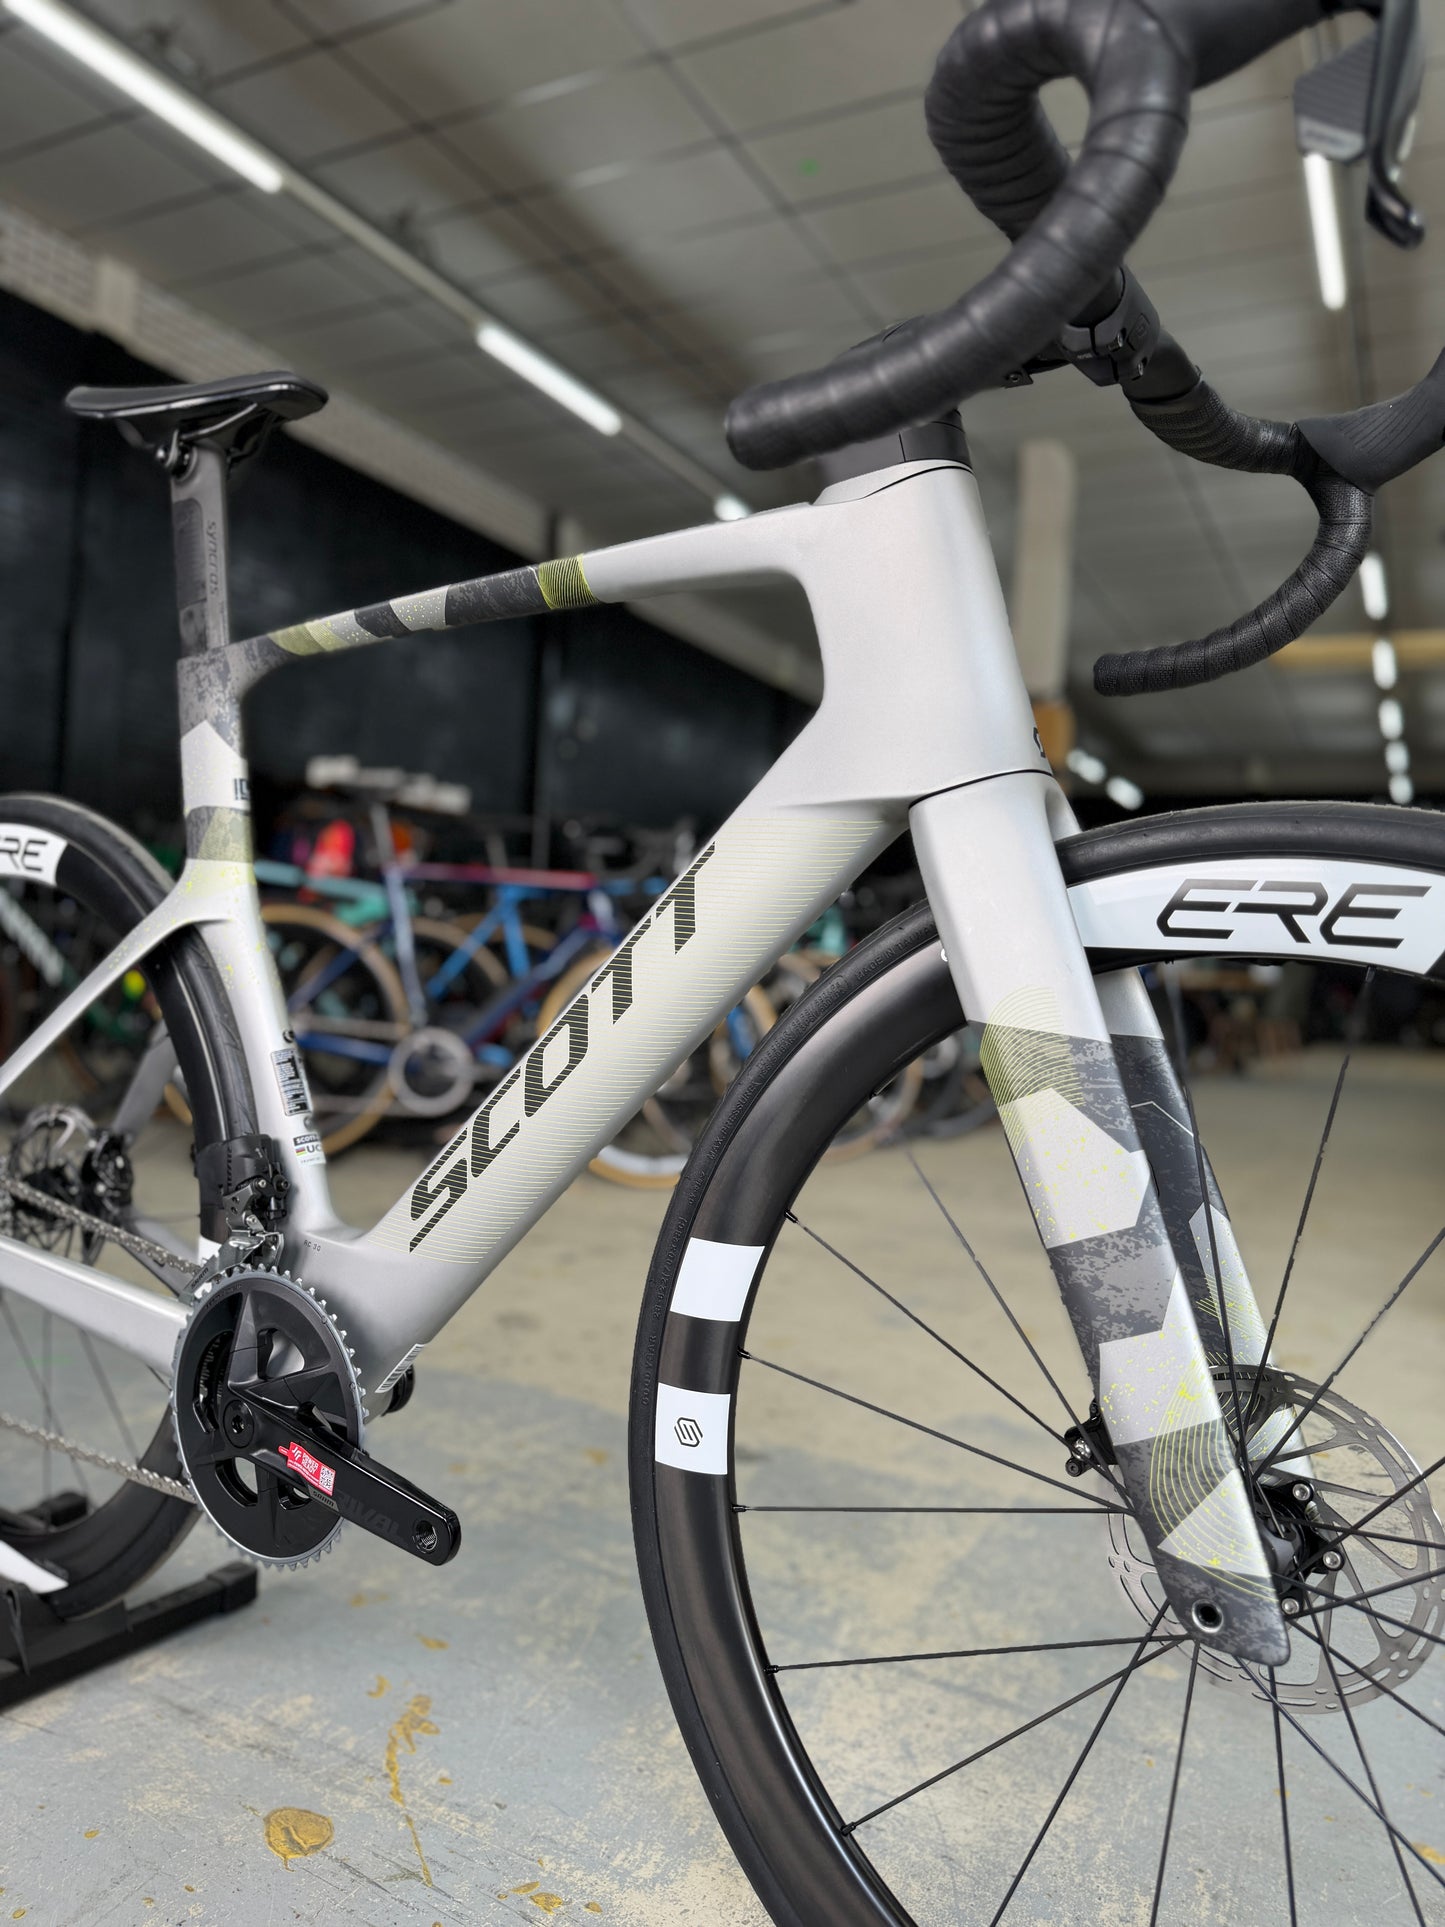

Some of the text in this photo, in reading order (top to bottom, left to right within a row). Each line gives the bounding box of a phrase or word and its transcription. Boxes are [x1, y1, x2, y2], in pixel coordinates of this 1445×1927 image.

[207, 521, 219, 596] syncros
[0, 837, 48, 871] RE
[1156, 878, 1433, 949] ERE
[855, 956, 883, 980] MADE
[410, 841, 715, 1253] SCOTT
[306, 1144, 321, 1154] UC
[336, 1488, 409, 1543] RIVAL
